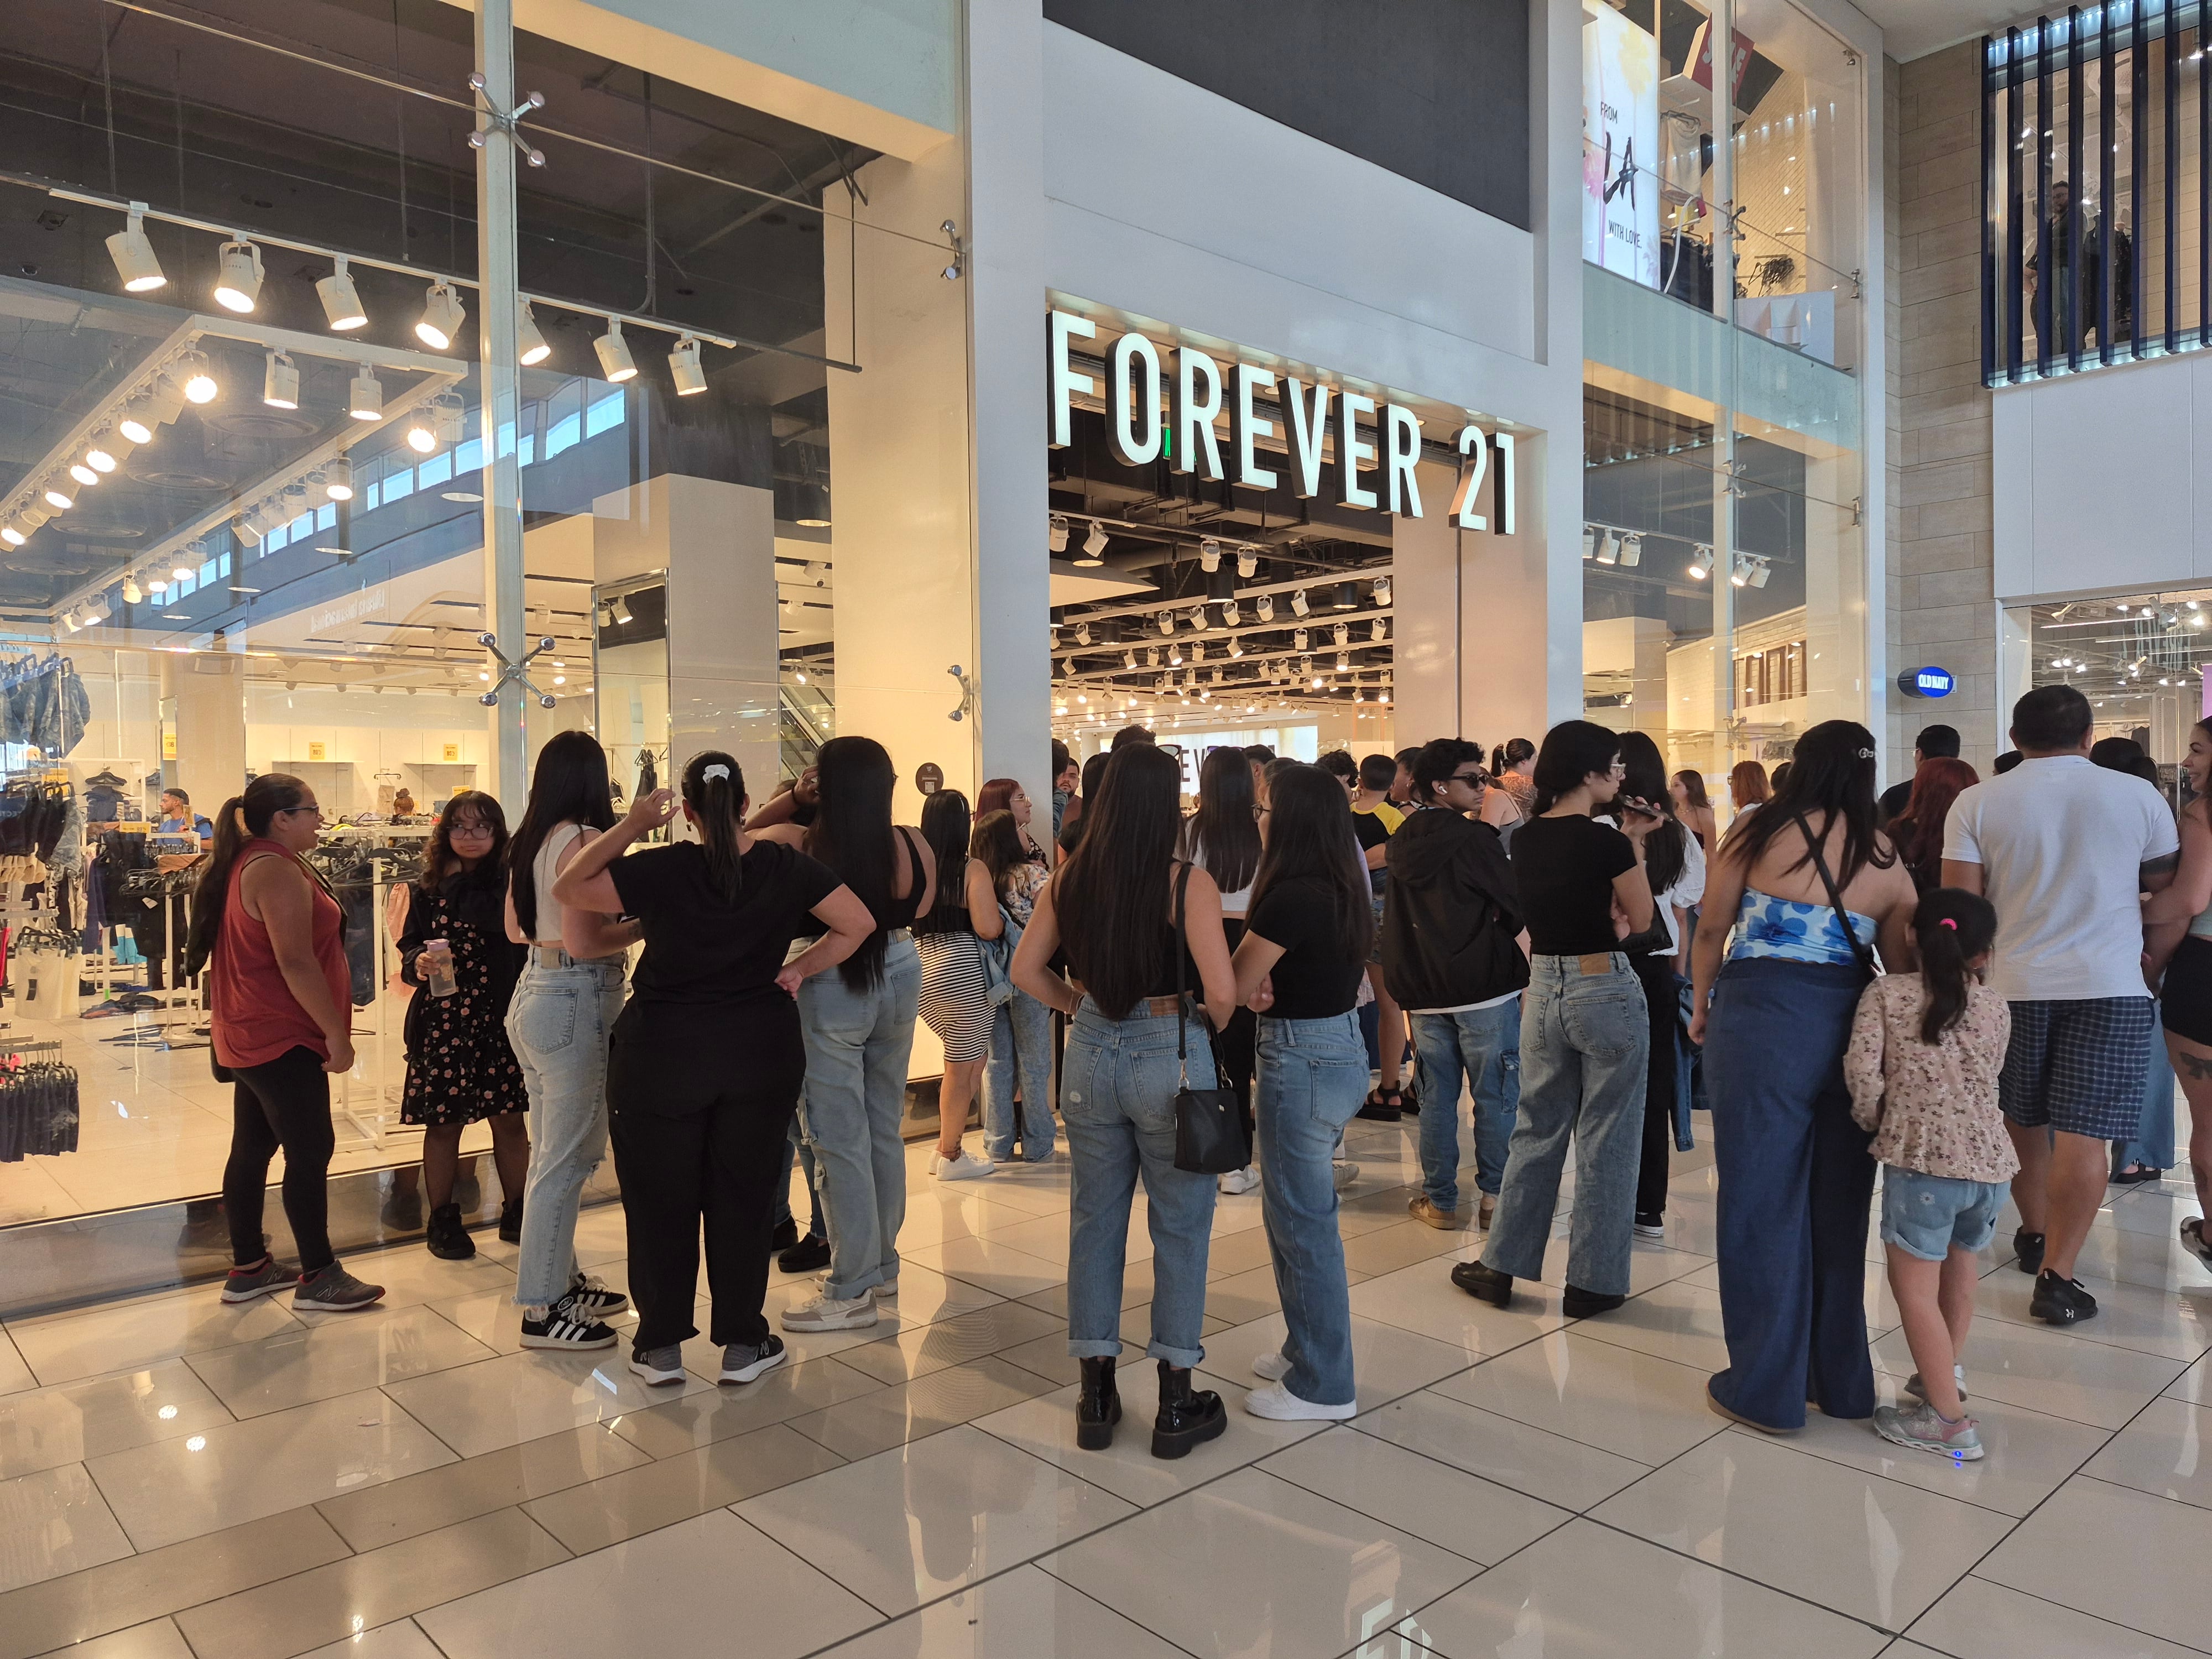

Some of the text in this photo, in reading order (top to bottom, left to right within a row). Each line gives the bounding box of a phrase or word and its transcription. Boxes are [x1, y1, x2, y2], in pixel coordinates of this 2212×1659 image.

[1600, 101, 1618, 124] FROM
[1603, 130, 1639, 211] LA
[1609, 219, 1642, 249] WITH LOVE.
[1047, 310, 1515, 536] FOREVER 21
[1918, 674, 1949, 690] OLD NAVY
